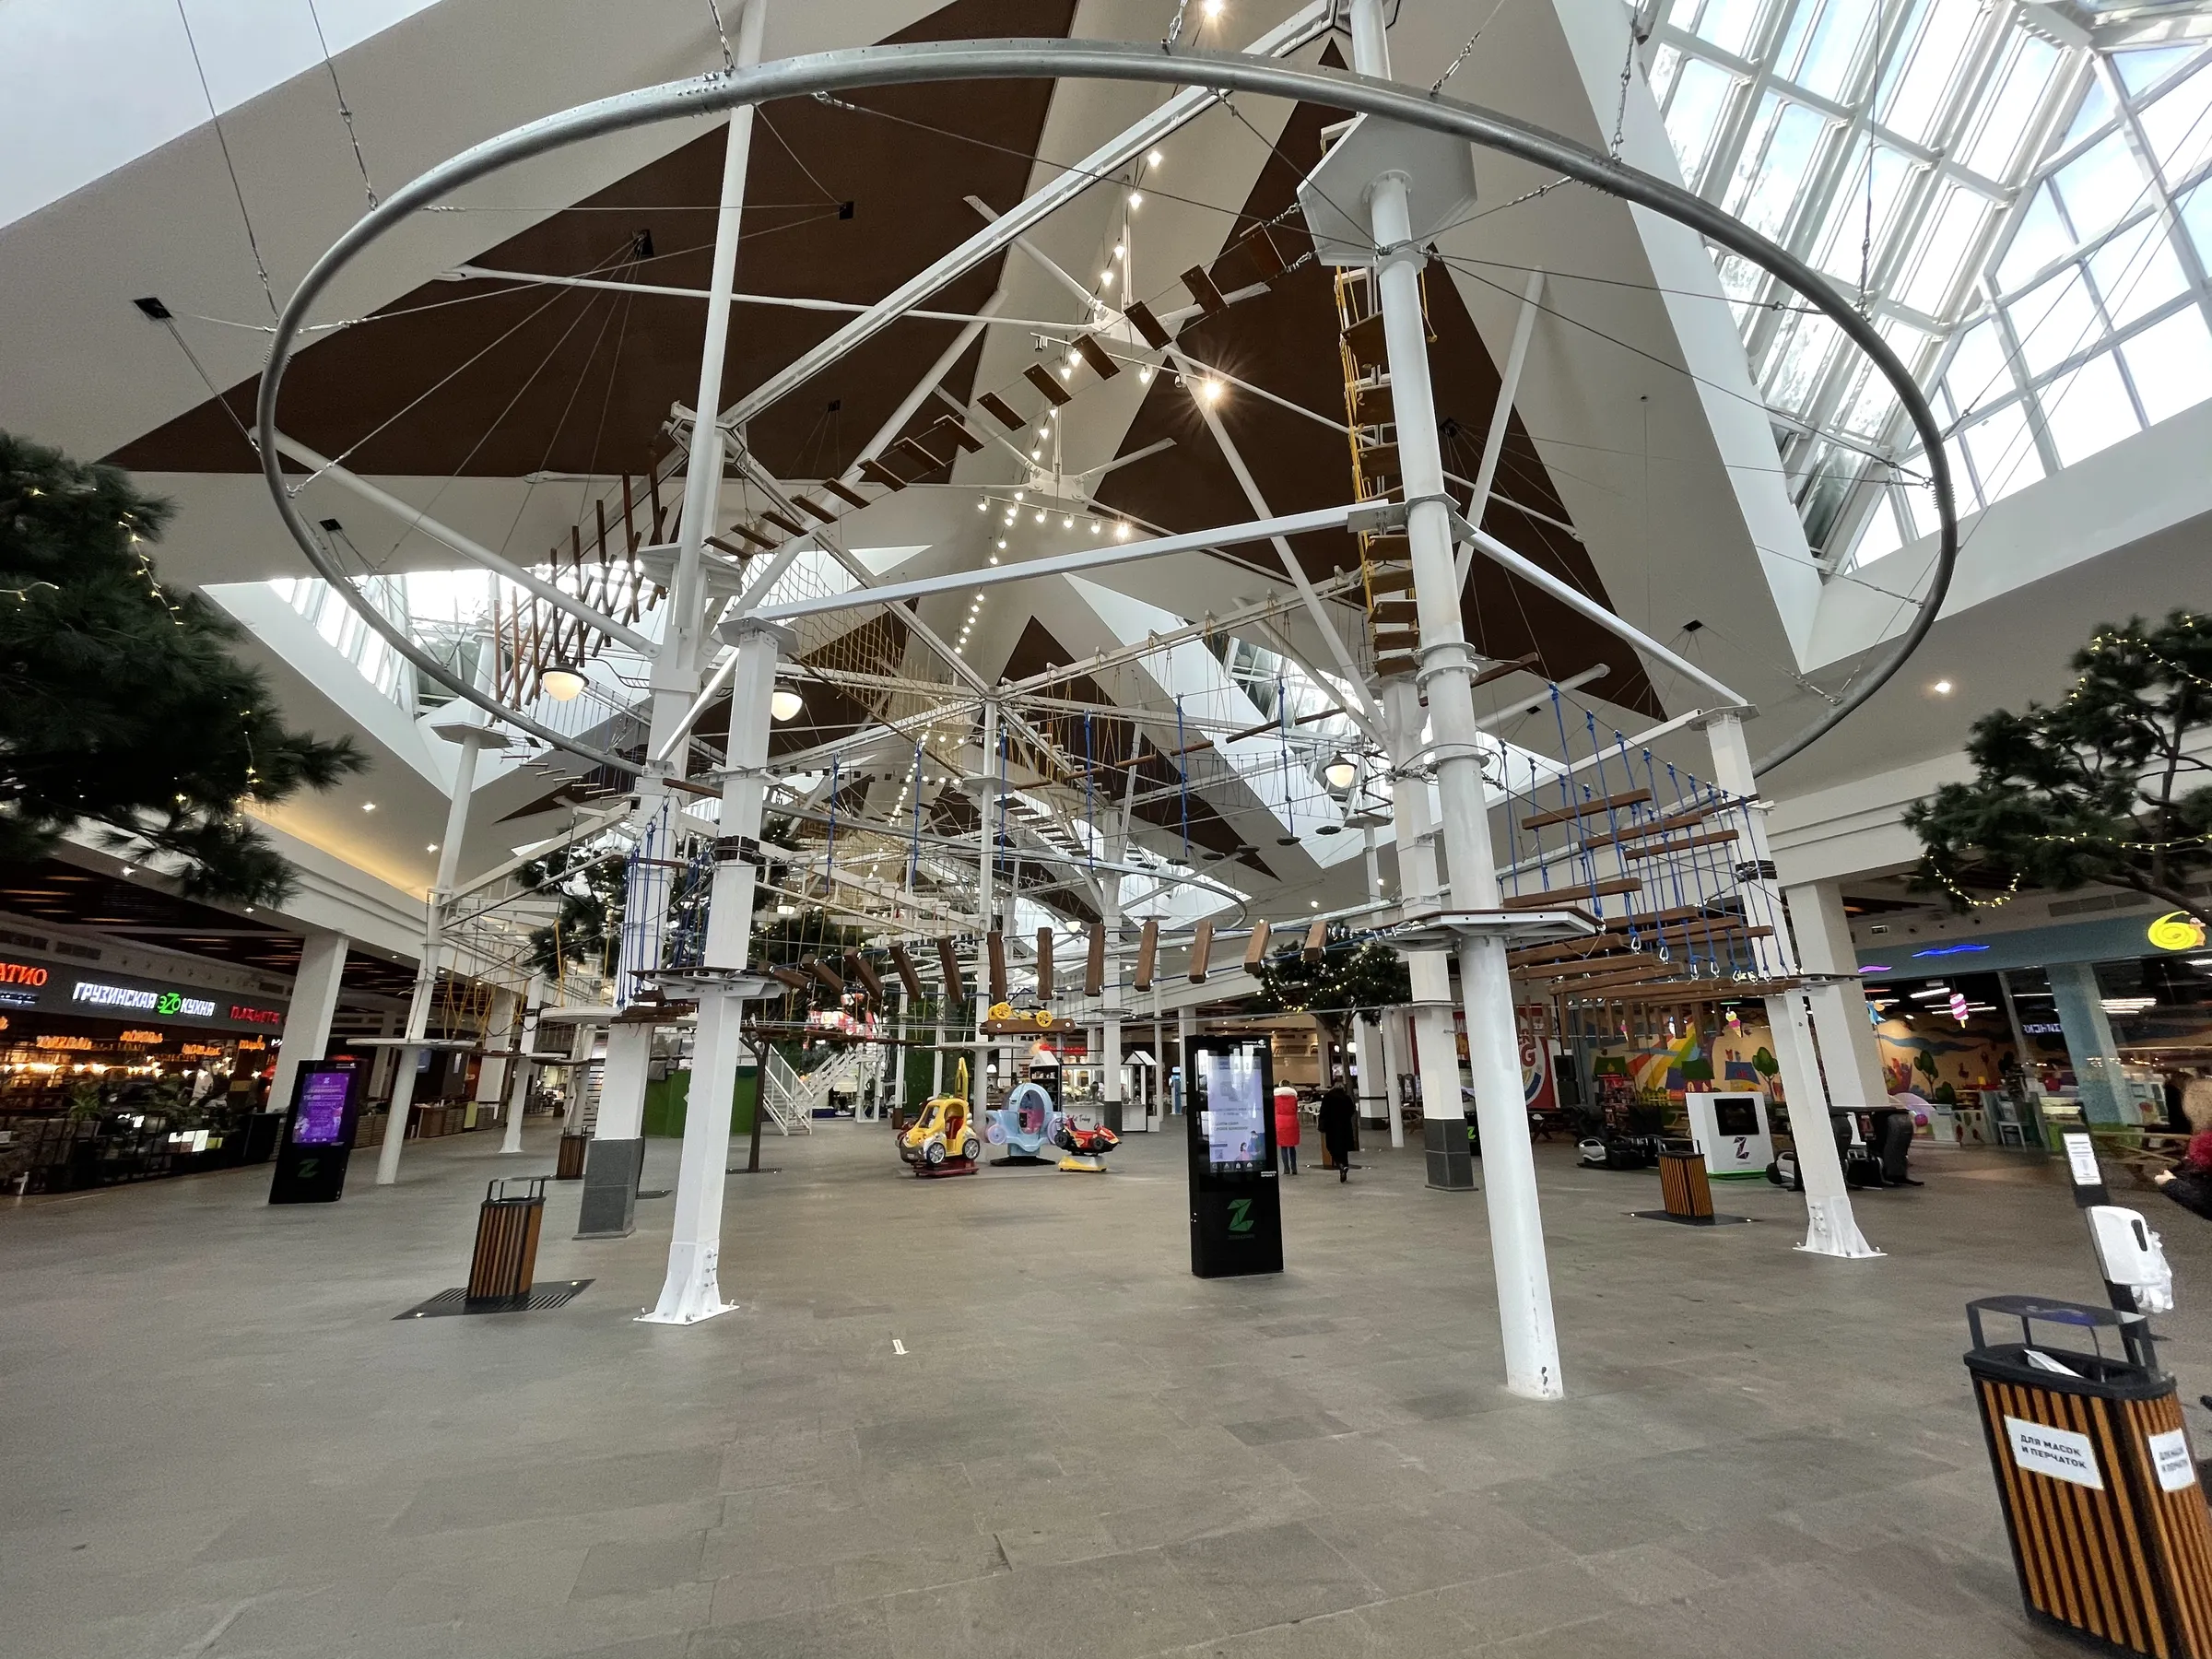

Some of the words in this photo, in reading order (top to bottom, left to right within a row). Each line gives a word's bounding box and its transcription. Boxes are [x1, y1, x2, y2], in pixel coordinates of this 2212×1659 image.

[72, 982, 159, 1009] ГРУЗИНСКАЯ
[180, 997, 216, 1017] КУХНЯ
[2020, 1434, 2041, 1446] ДЛЯ
[2043, 1441, 2082, 1456] МАСОК
[2021, 1445, 2029, 1453] И
[2030, 1448, 2088, 1469] ПЕРЧАТОК
